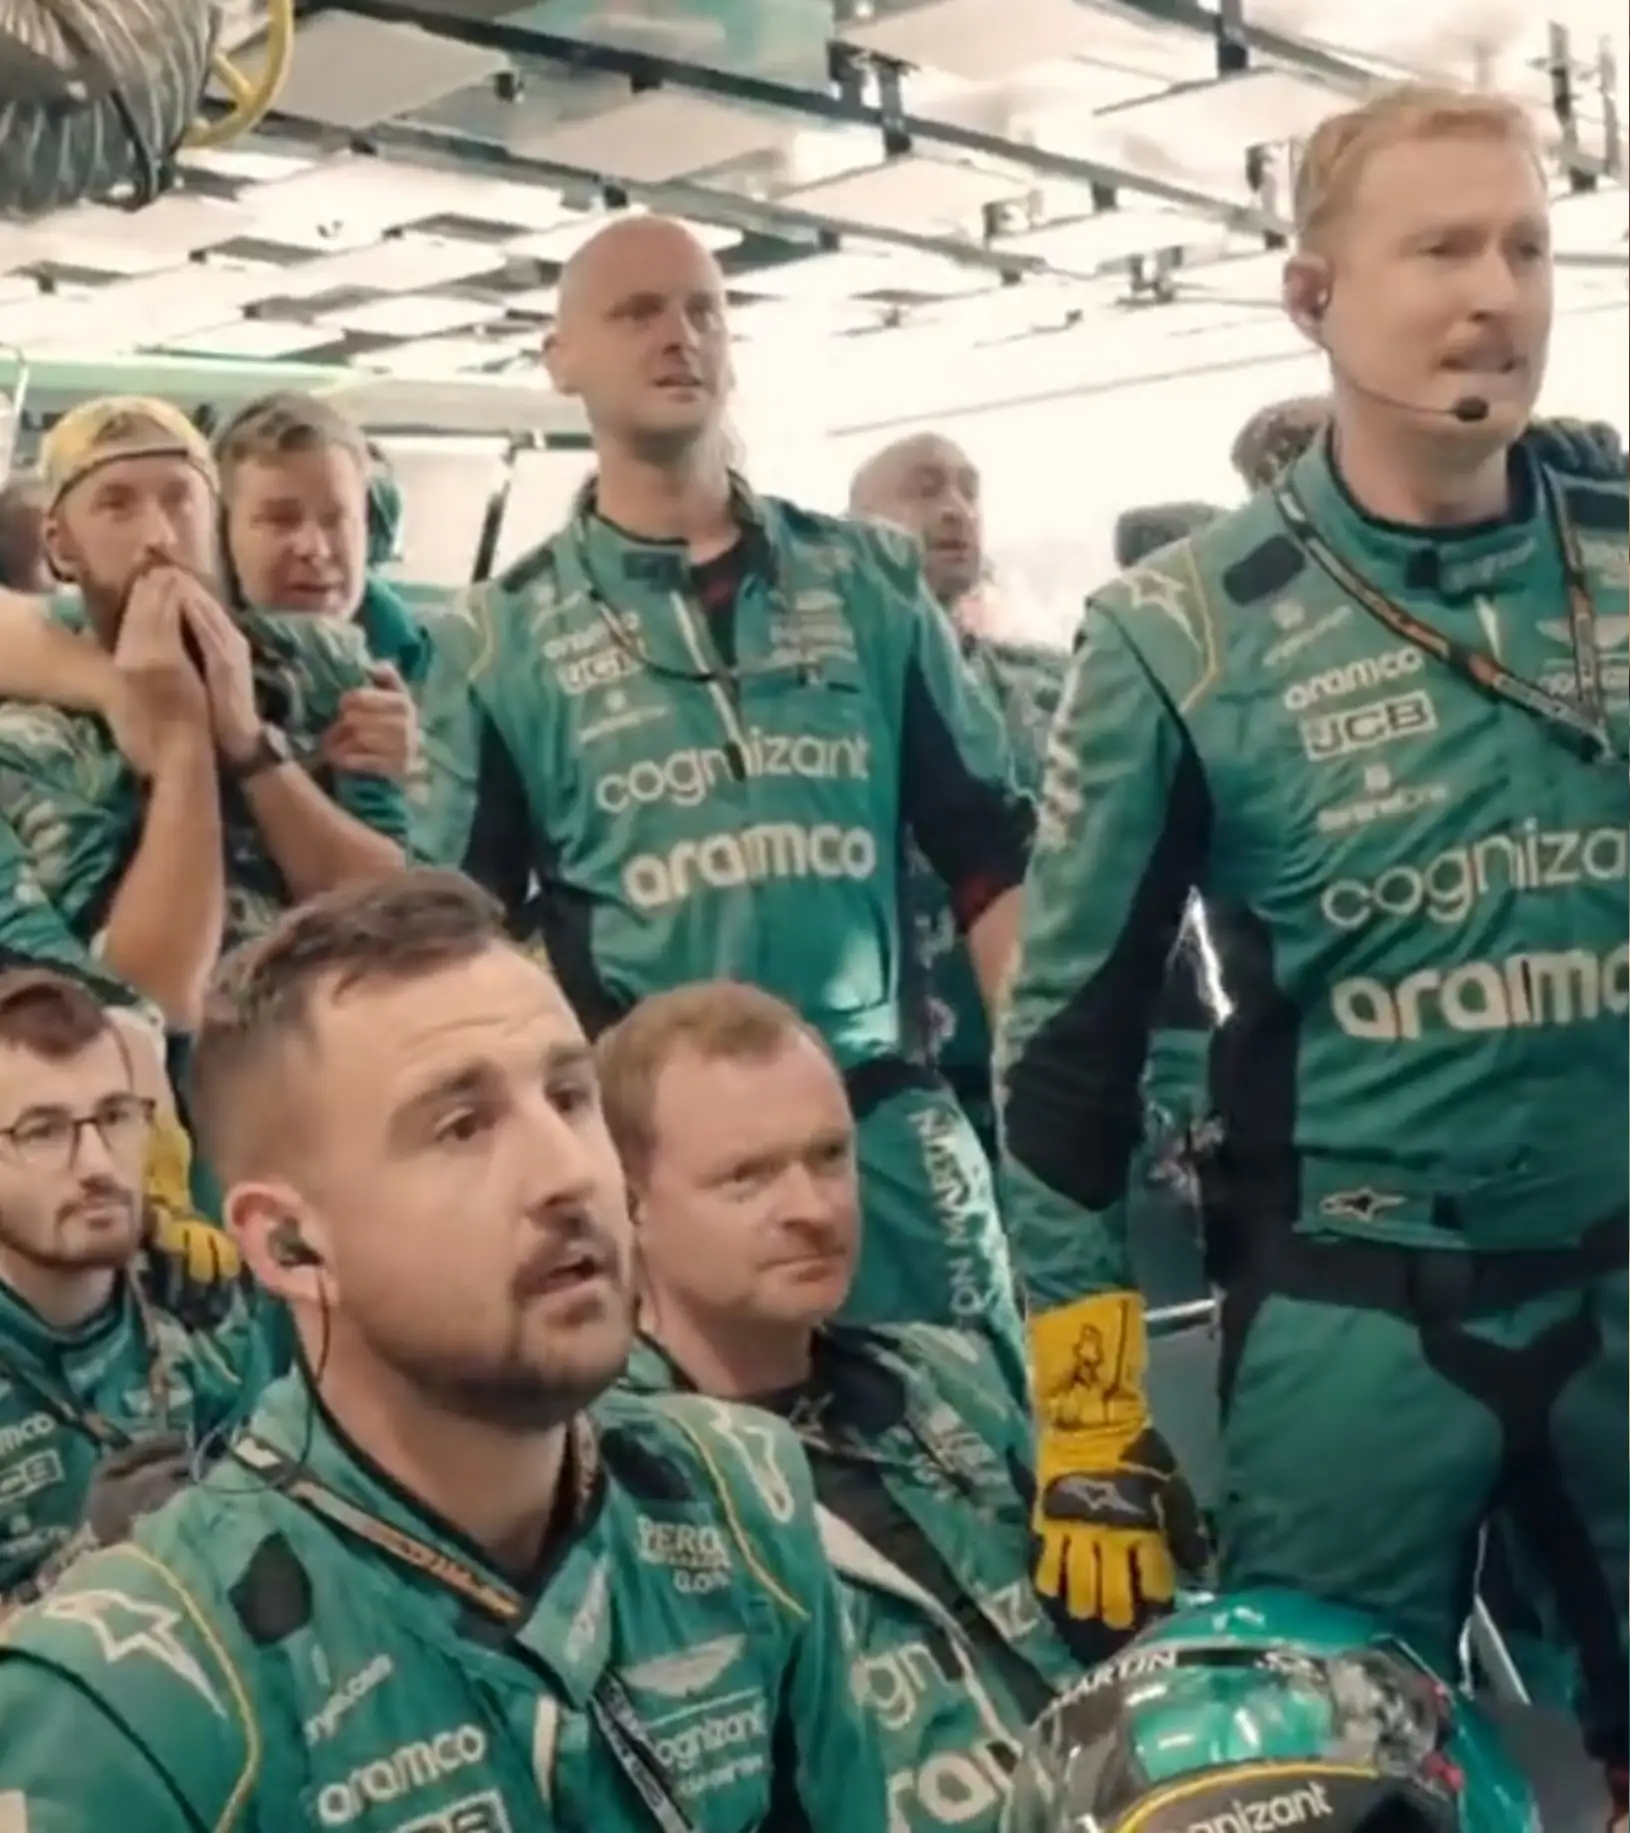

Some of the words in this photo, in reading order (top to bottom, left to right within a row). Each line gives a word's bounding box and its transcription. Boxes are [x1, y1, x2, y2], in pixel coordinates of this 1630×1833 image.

[1282, 645, 1426, 711] aramco
[1305, 692, 1436, 760] JCB
[596, 727, 870, 813] cognizant
[622, 822, 877, 908] aramco
[317, 1723, 487, 1827] aramco
